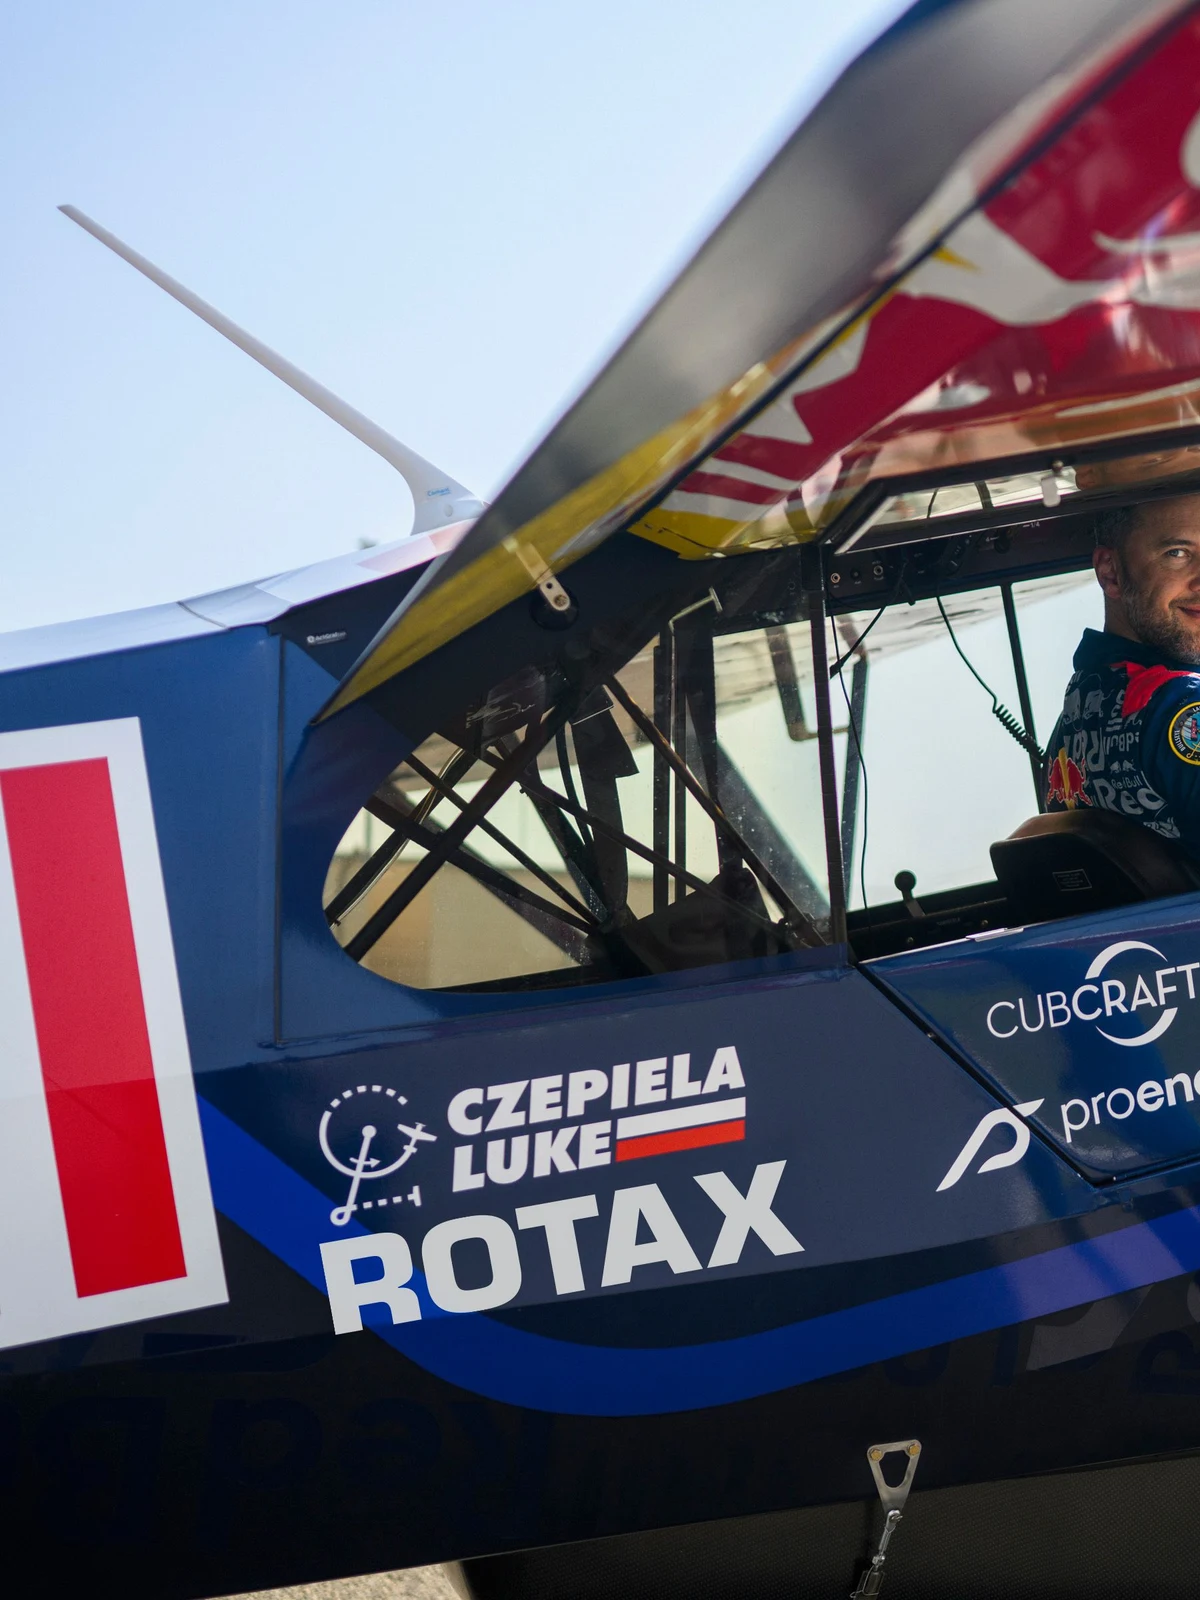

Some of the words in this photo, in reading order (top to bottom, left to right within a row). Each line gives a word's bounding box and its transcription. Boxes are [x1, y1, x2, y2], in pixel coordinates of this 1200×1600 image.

[447, 1045, 746, 1137] CZEPIELA
[452, 1120, 613, 1193] LUKE
[319, 1159, 806, 1336] ROTAX
